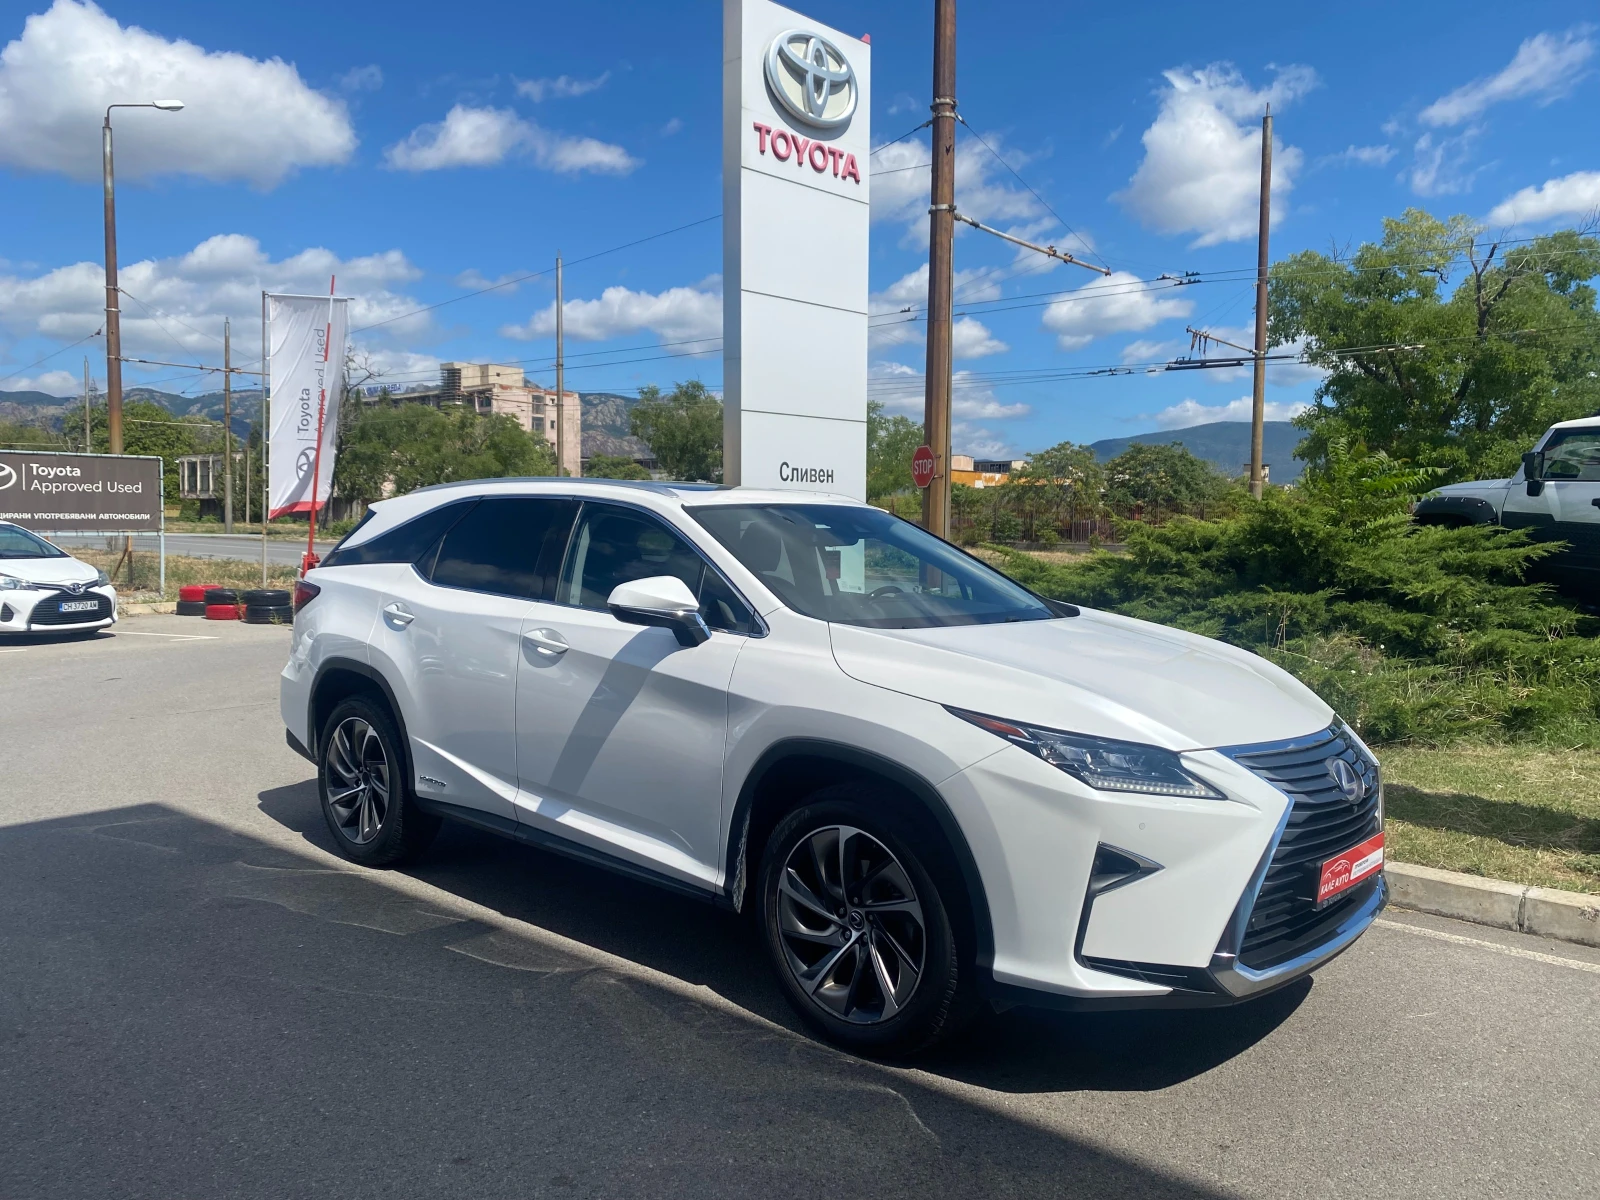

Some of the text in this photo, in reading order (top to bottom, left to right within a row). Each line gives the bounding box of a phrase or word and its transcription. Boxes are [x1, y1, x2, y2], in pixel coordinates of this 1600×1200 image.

[753, 121, 860, 184] TOYOTA
[313, 328, 326, 363] Used
[297, 388, 312, 433] Toyota
[30, 463, 81, 478] Toyota
[779, 461, 834, 484] Сливен
[914, 459, 933, 475] STOP
[30, 480, 142, 494] Approved Used
[33, 512, 96, 520] УПОТРЕБЯВАНИ
